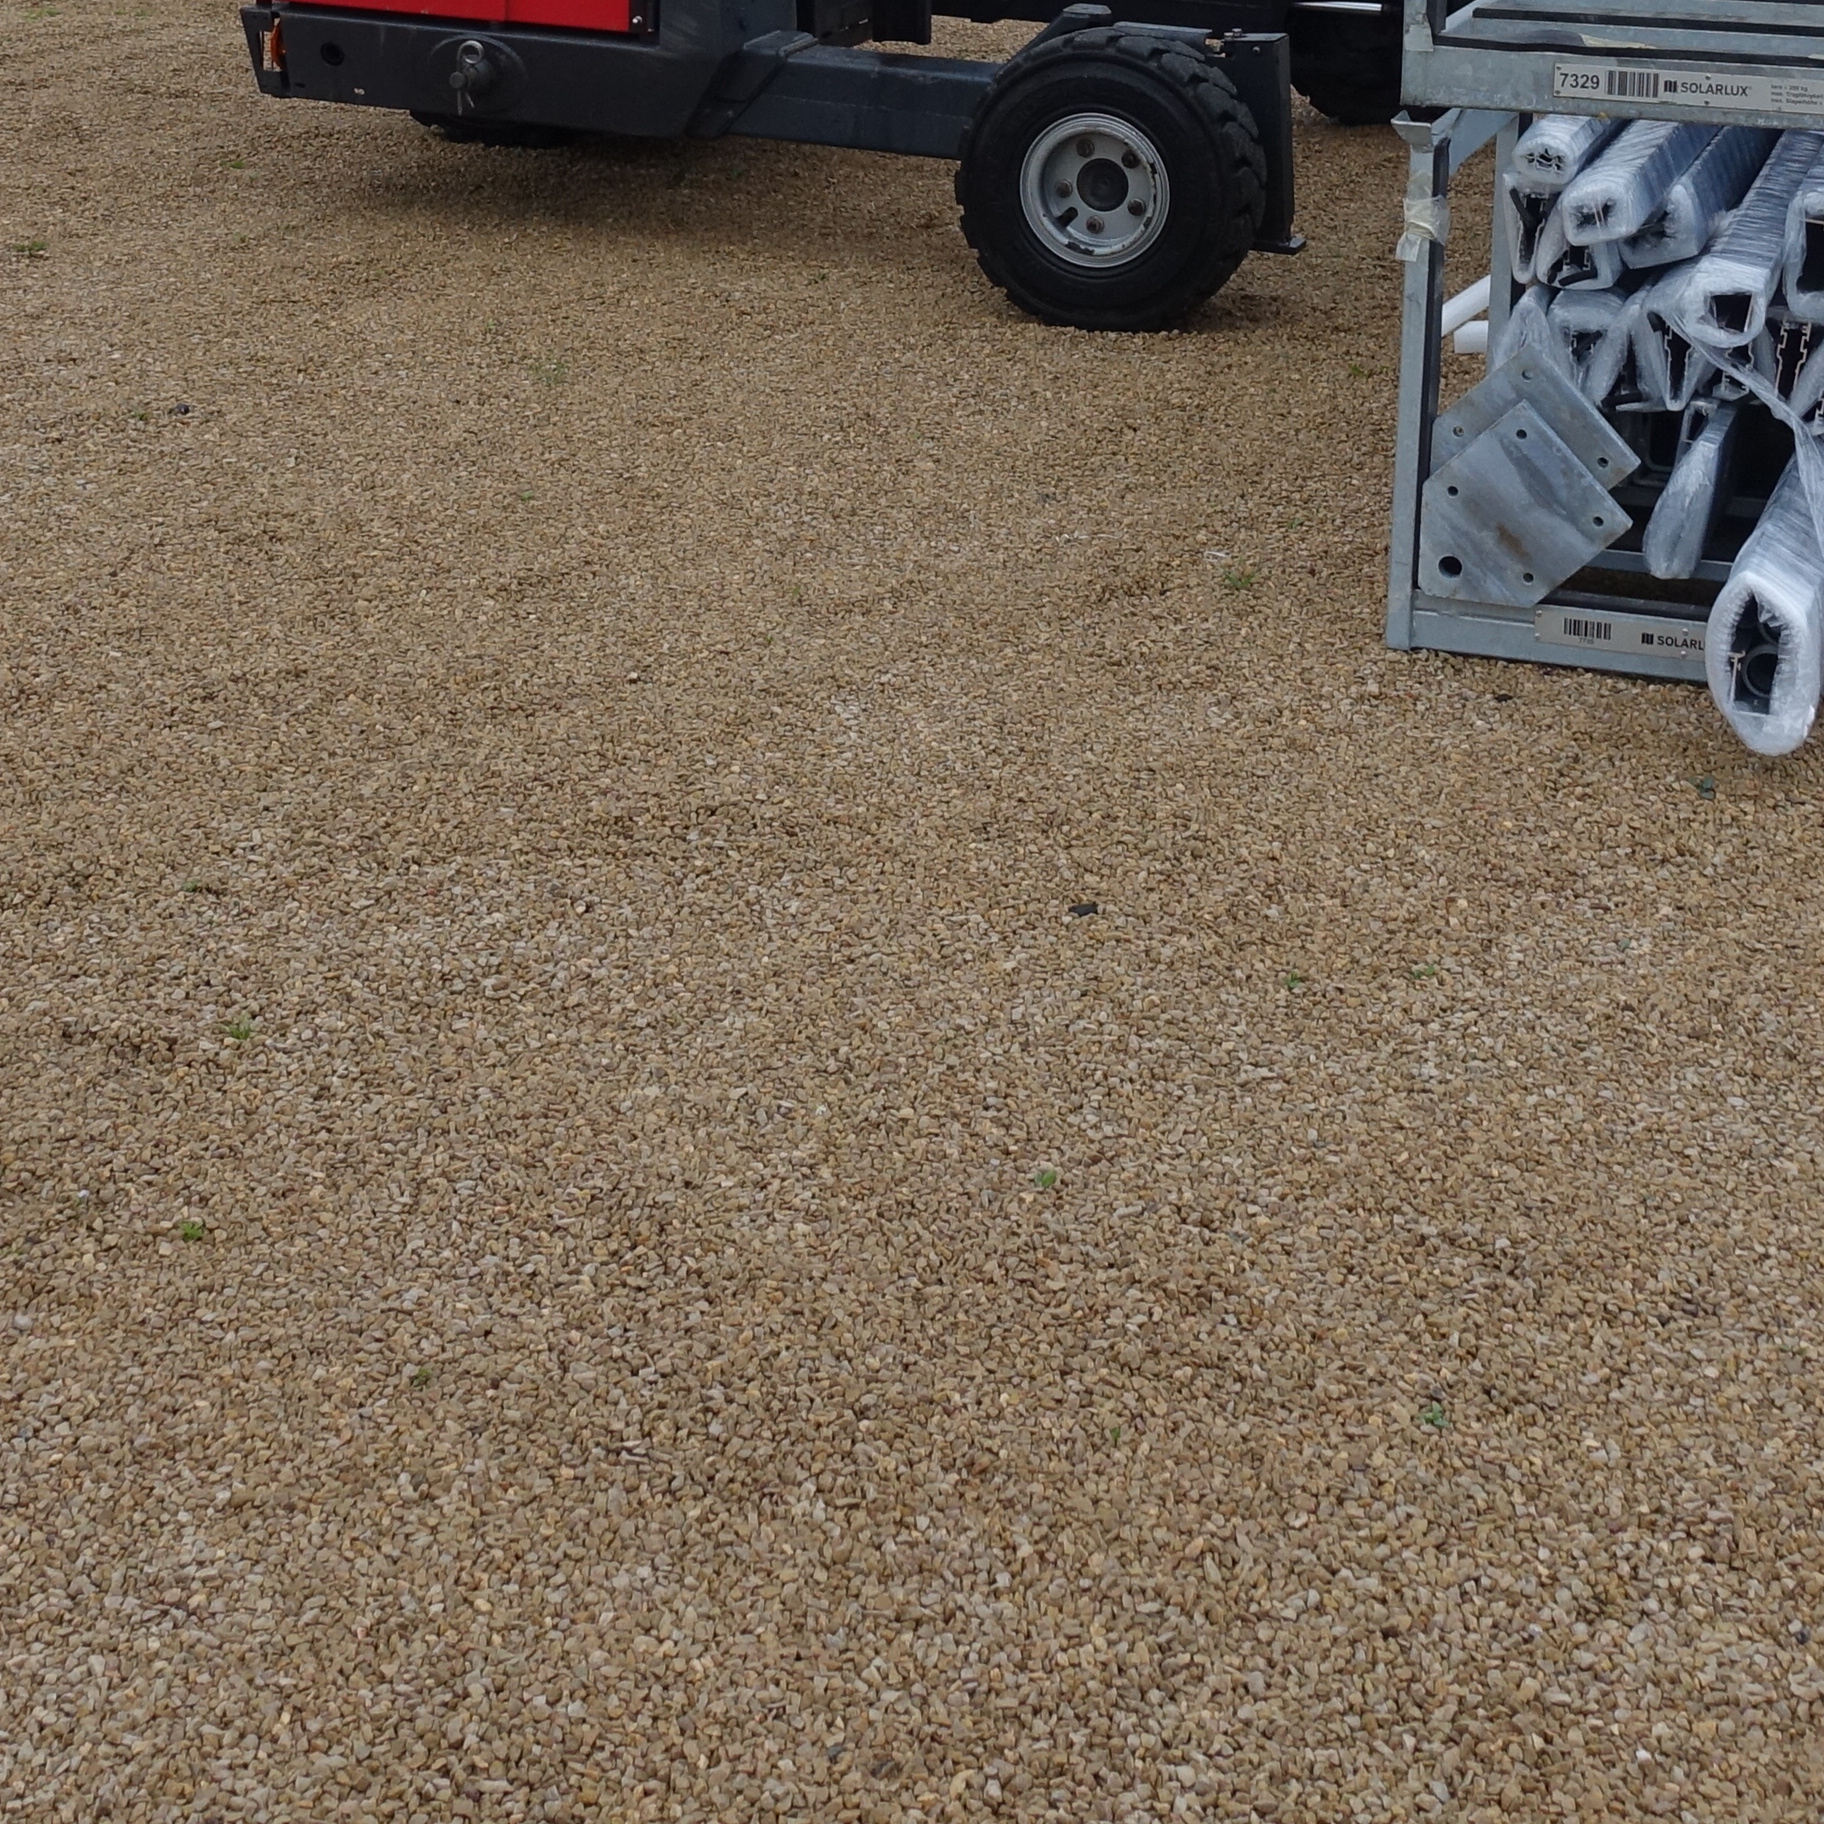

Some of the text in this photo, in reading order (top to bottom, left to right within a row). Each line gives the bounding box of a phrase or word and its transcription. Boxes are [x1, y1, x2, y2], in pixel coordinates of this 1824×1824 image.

[1559, 72, 1601, 90] 7329
[1680, 81, 1749, 97] SOLARLUX
[1657, 635, 1704, 651] SOLARL
